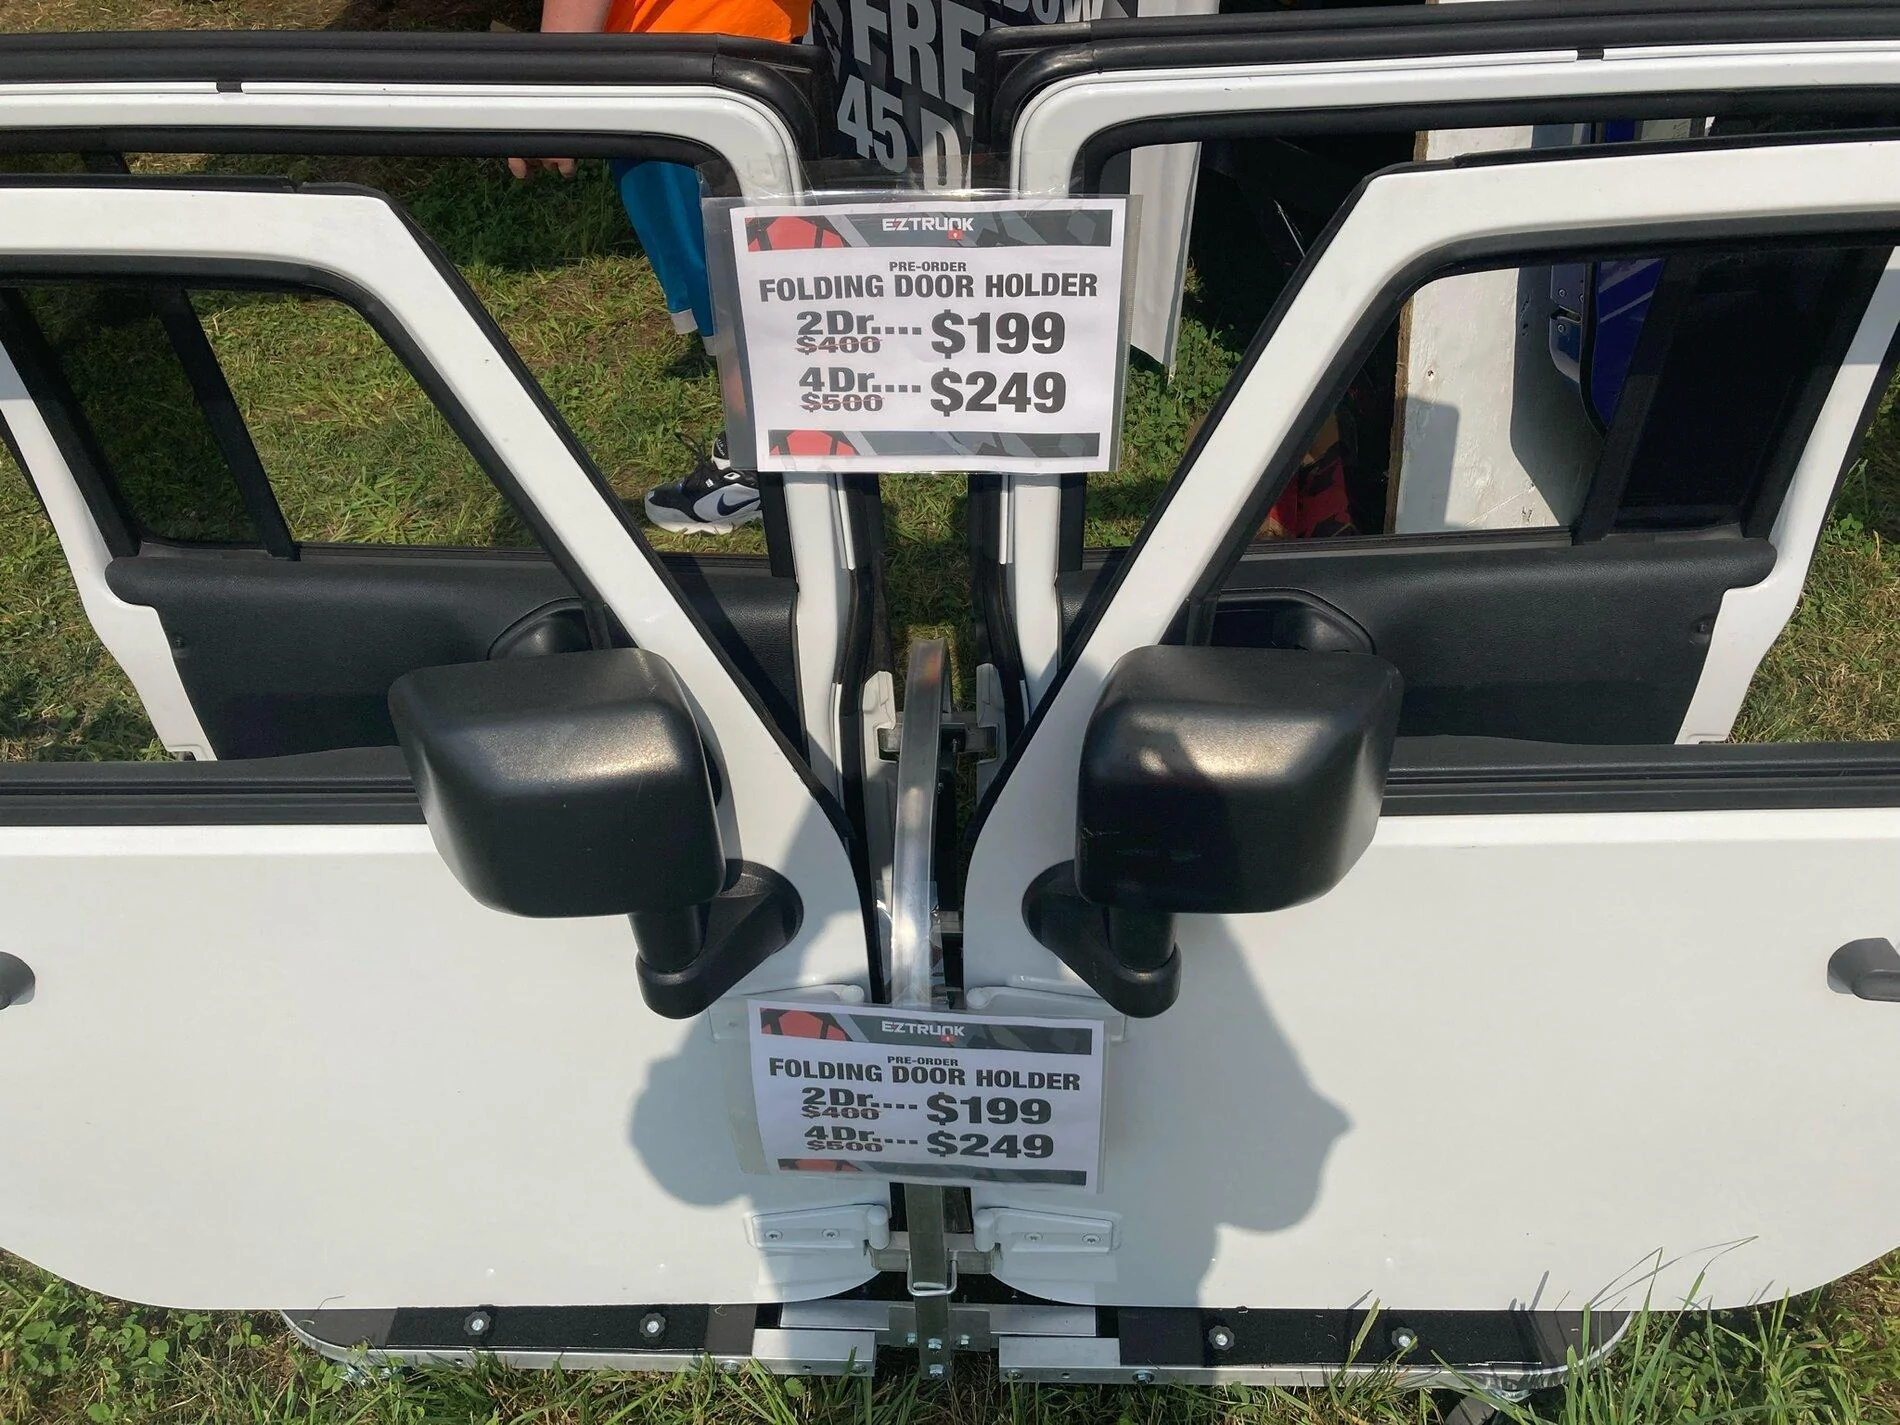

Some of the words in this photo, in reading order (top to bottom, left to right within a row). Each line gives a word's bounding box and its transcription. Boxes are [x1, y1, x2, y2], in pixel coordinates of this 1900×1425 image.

[837, 74, 908, 174] 45
[882, 217, 975, 232] EZTRUNK
[889, 261, 967, 272] PRE-ORDER
[759, 274, 884, 302] FOLDING
[894, 274, 973, 298] DOOR
[985, 272, 1098, 298] HOLDER
[931, 309, 1066, 359] $199
[795, 335, 882, 355] $400
[800, 392, 884, 412] $500
[930, 367, 1067, 417] $249
[881, 1020, 965, 1037] EZTRUNK
[887, 1055, 959, 1067] PRE-ORDER
[769, 1057, 882, 1083] FOLDING
[892, 1065, 966, 1086] DOOR
[976, 1069, 1080, 1090] HOLDER
[801, 1105, 881, 1120] $400
[926, 1092, 1052, 1125] $199
[806, 1140, 884, 1152] $500
[926, 1130, 1054, 1157] $249
